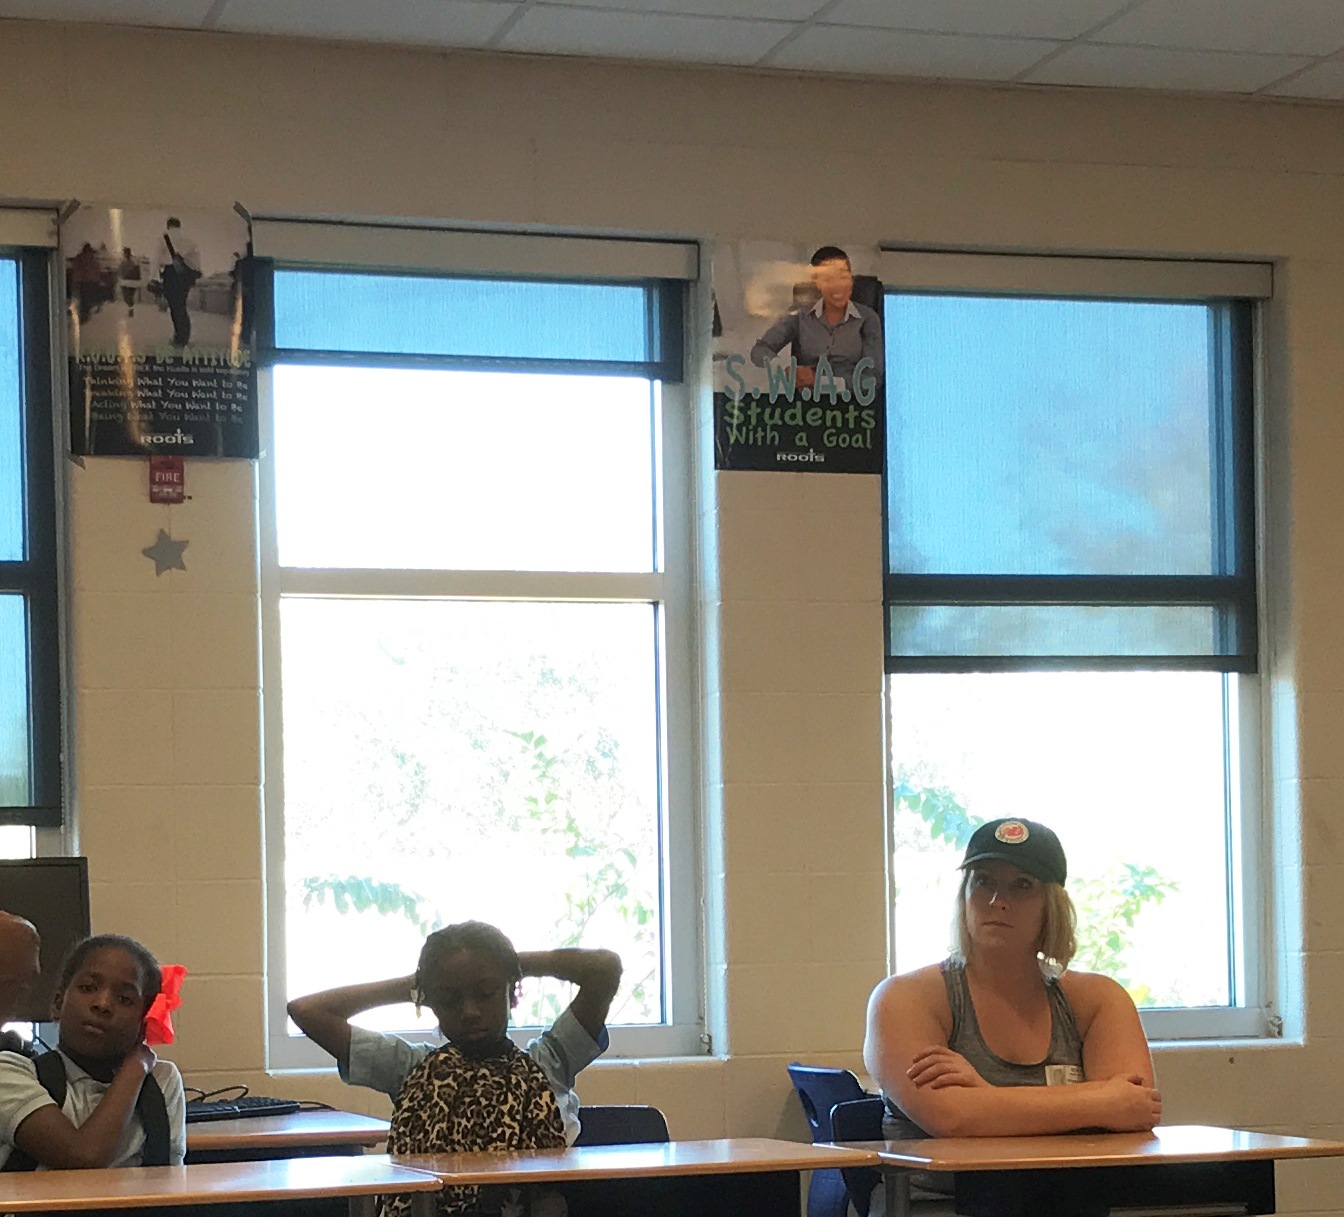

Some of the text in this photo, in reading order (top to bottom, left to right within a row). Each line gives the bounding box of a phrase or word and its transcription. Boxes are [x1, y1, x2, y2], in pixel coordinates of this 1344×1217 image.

[167, 377, 189, 388] You
[167, 389, 189, 399] You
[160, 400, 183, 411] You
[723, 400, 876, 429] Students
[726, 424, 872, 449] With a Goal
[155, 472, 180, 483] FIRE
